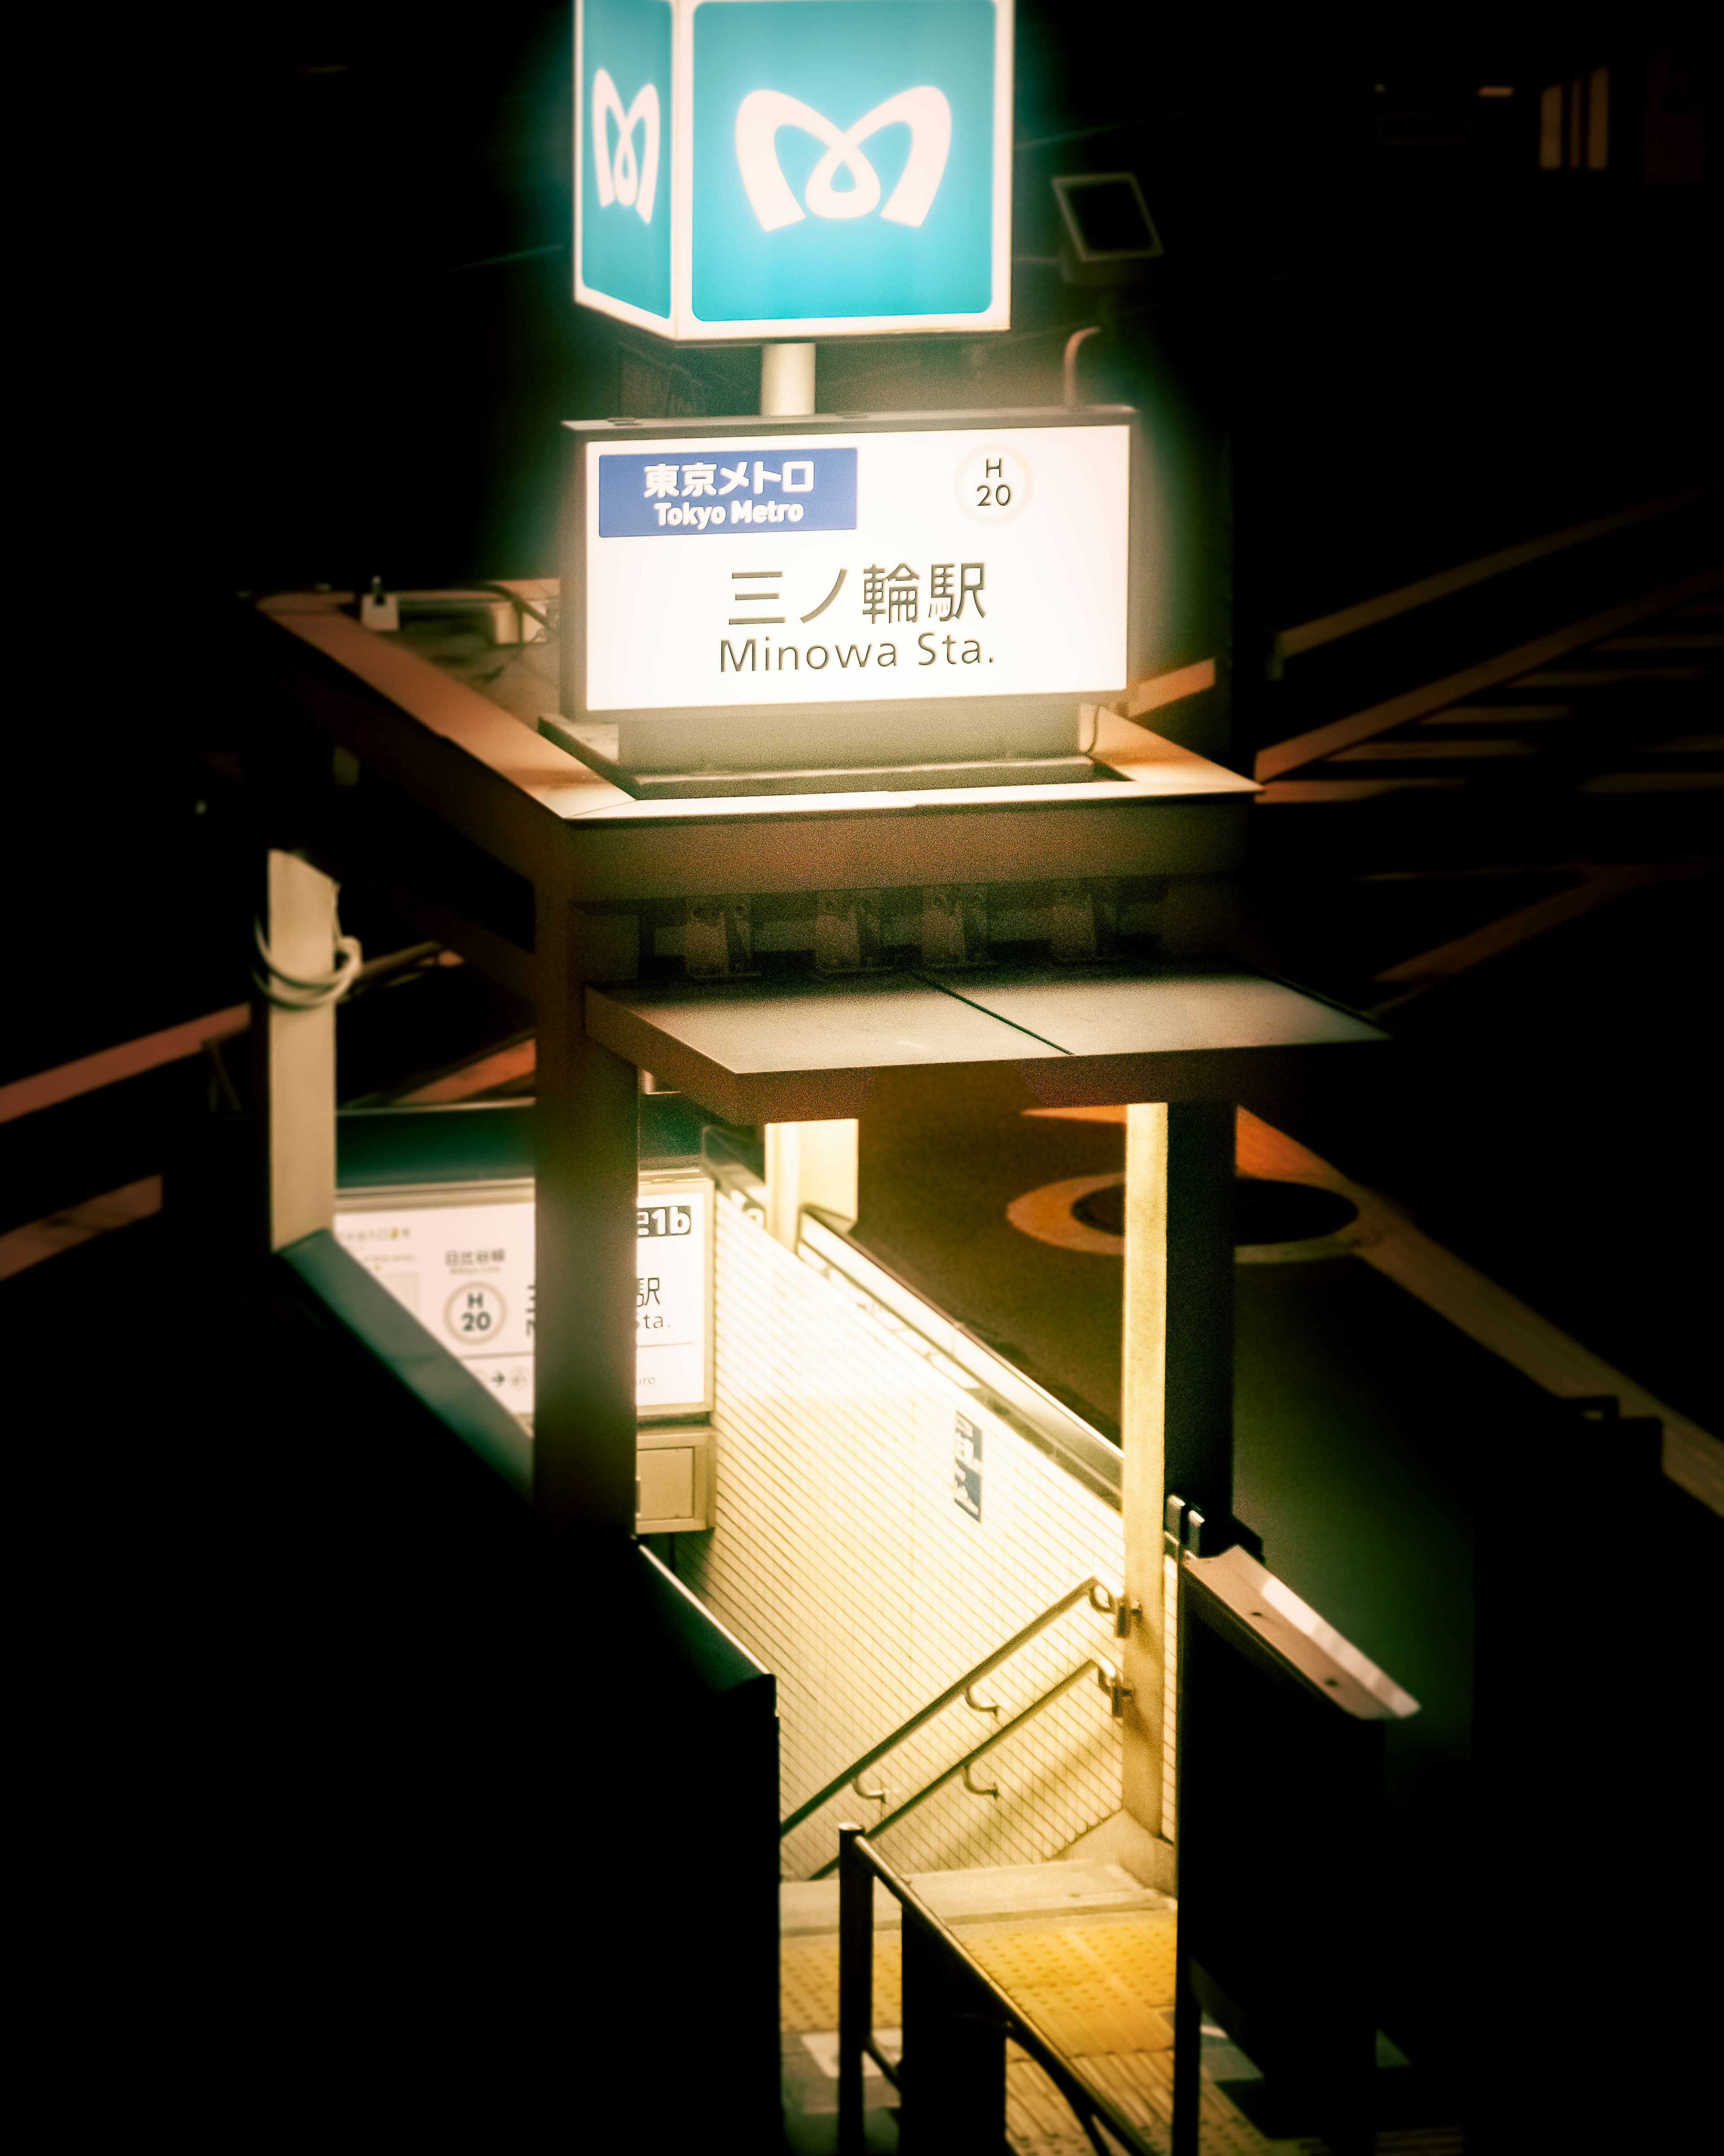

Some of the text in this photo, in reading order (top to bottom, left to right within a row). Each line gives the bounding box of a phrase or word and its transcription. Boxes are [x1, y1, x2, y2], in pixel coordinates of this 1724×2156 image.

[644, 461, 814, 498] 東京メトロ
[986, 458, 1003, 478] H
[977, 484, 1012, 506] 20
[654, 500, 804, 530] Tokyo Metro
[728, 562, 986, 625] 三ノ輪駅
[721, 632, 994, 673] Minowa Sta.
[467, 1292, 484, 1309] H
[461, 1311, 492, 1333] 20
